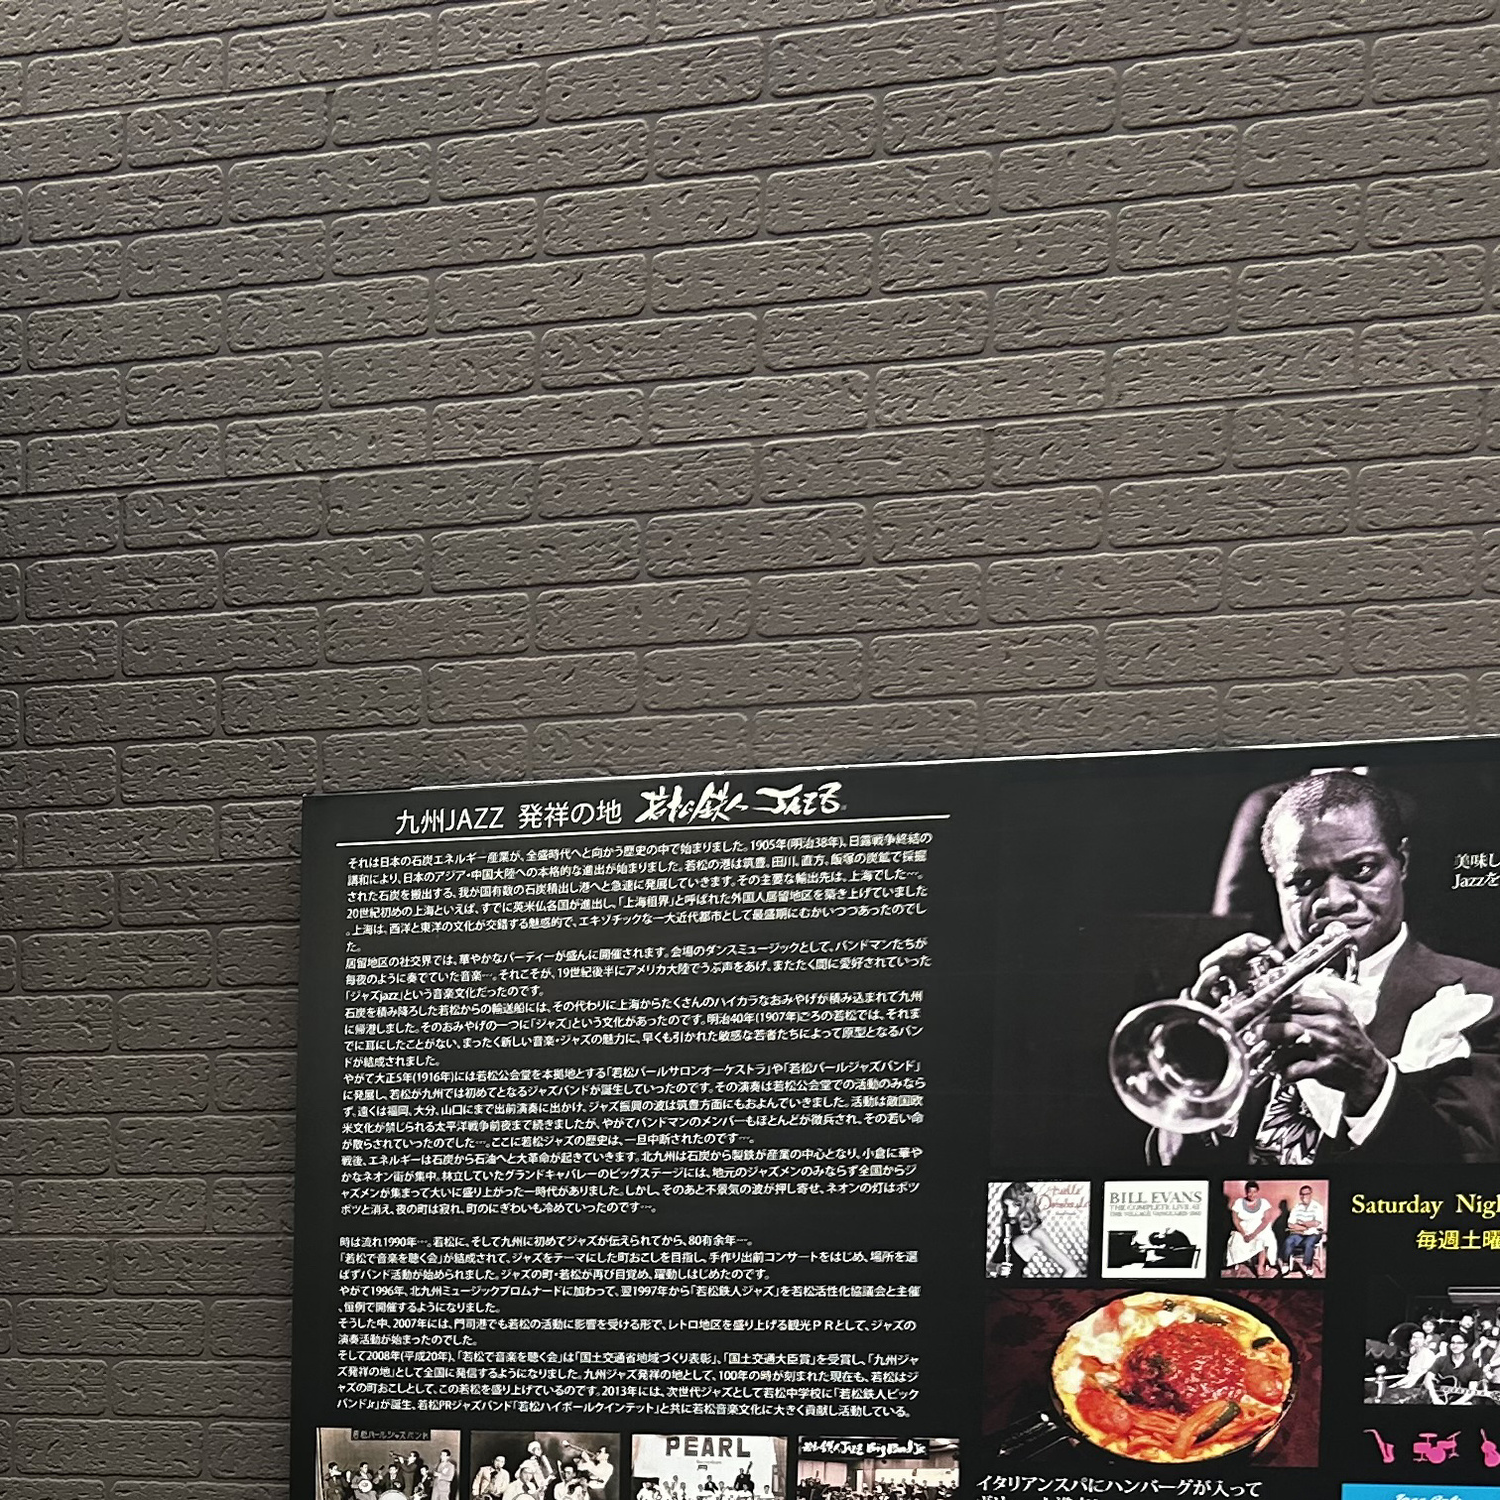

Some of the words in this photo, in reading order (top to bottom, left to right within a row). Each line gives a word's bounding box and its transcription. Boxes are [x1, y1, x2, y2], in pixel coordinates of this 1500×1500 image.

[395, 807, 505, 835] 九州JAZZ
[518, 799, 623, 830] 発祥の地
[1453, 852, 1500, 870] 美味し
[1109, 1191, 1148, 1204] BILL
[1151, 1191, 1203, 1204] EVANS
[1351, 1193, 1444, 1220] Saturday
[1415, 1229, 1500, 1251] 毎週土曜
[665, 1436, 751, 1458] PEARL
[975, 1475, 1263, 1498] イタリアンスパにハンバーグが入って
